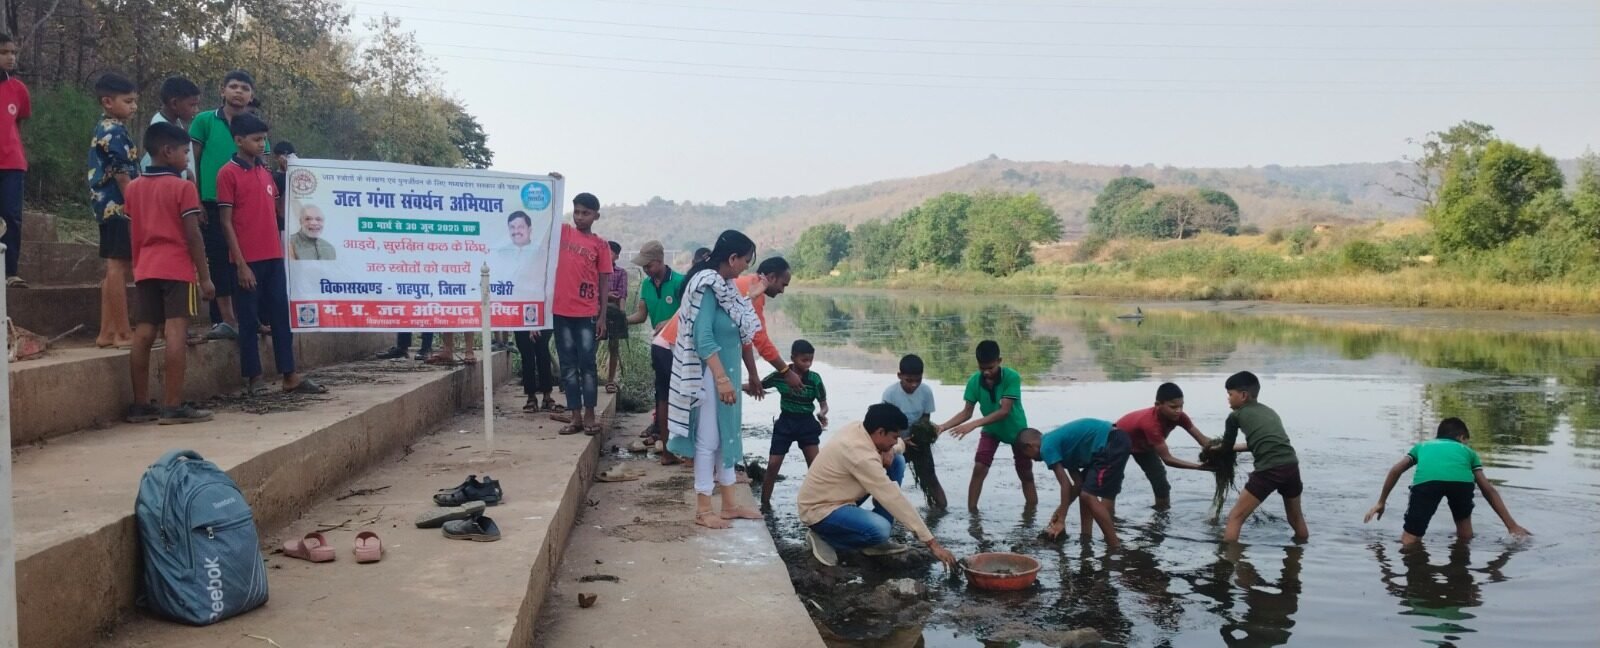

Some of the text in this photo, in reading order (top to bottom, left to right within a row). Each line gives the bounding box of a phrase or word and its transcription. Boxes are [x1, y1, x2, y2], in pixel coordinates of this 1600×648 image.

[332, 190, 361, 207] जल
[366, 187, 395, 208] गंगा
[450, 192, 504, 213] अभियान
[361, 221, 373, 229] 30
[394, 220, 402, 230] से
[405, 222, 417, 231] 30
[420, 223, 434, 233] जून
[461, 225, 476, 233] तक
[383, 237, 424, 254] सुरक्षित
[427, 242, 449, 251] कल
[451, 240, 462, 251] के
[366, 262, 386, 272] जल
[423, 261, 438, 273] को
[320, 279, 383, 294] विकासखण्ड
[438, 280, 466, 295] जिला
[322, 304, 343, 316] म.
[376, 305, 405, 316] जन
[412, 302, 475, 317] अभियान
[490, 302, 520, 316] रिषद
